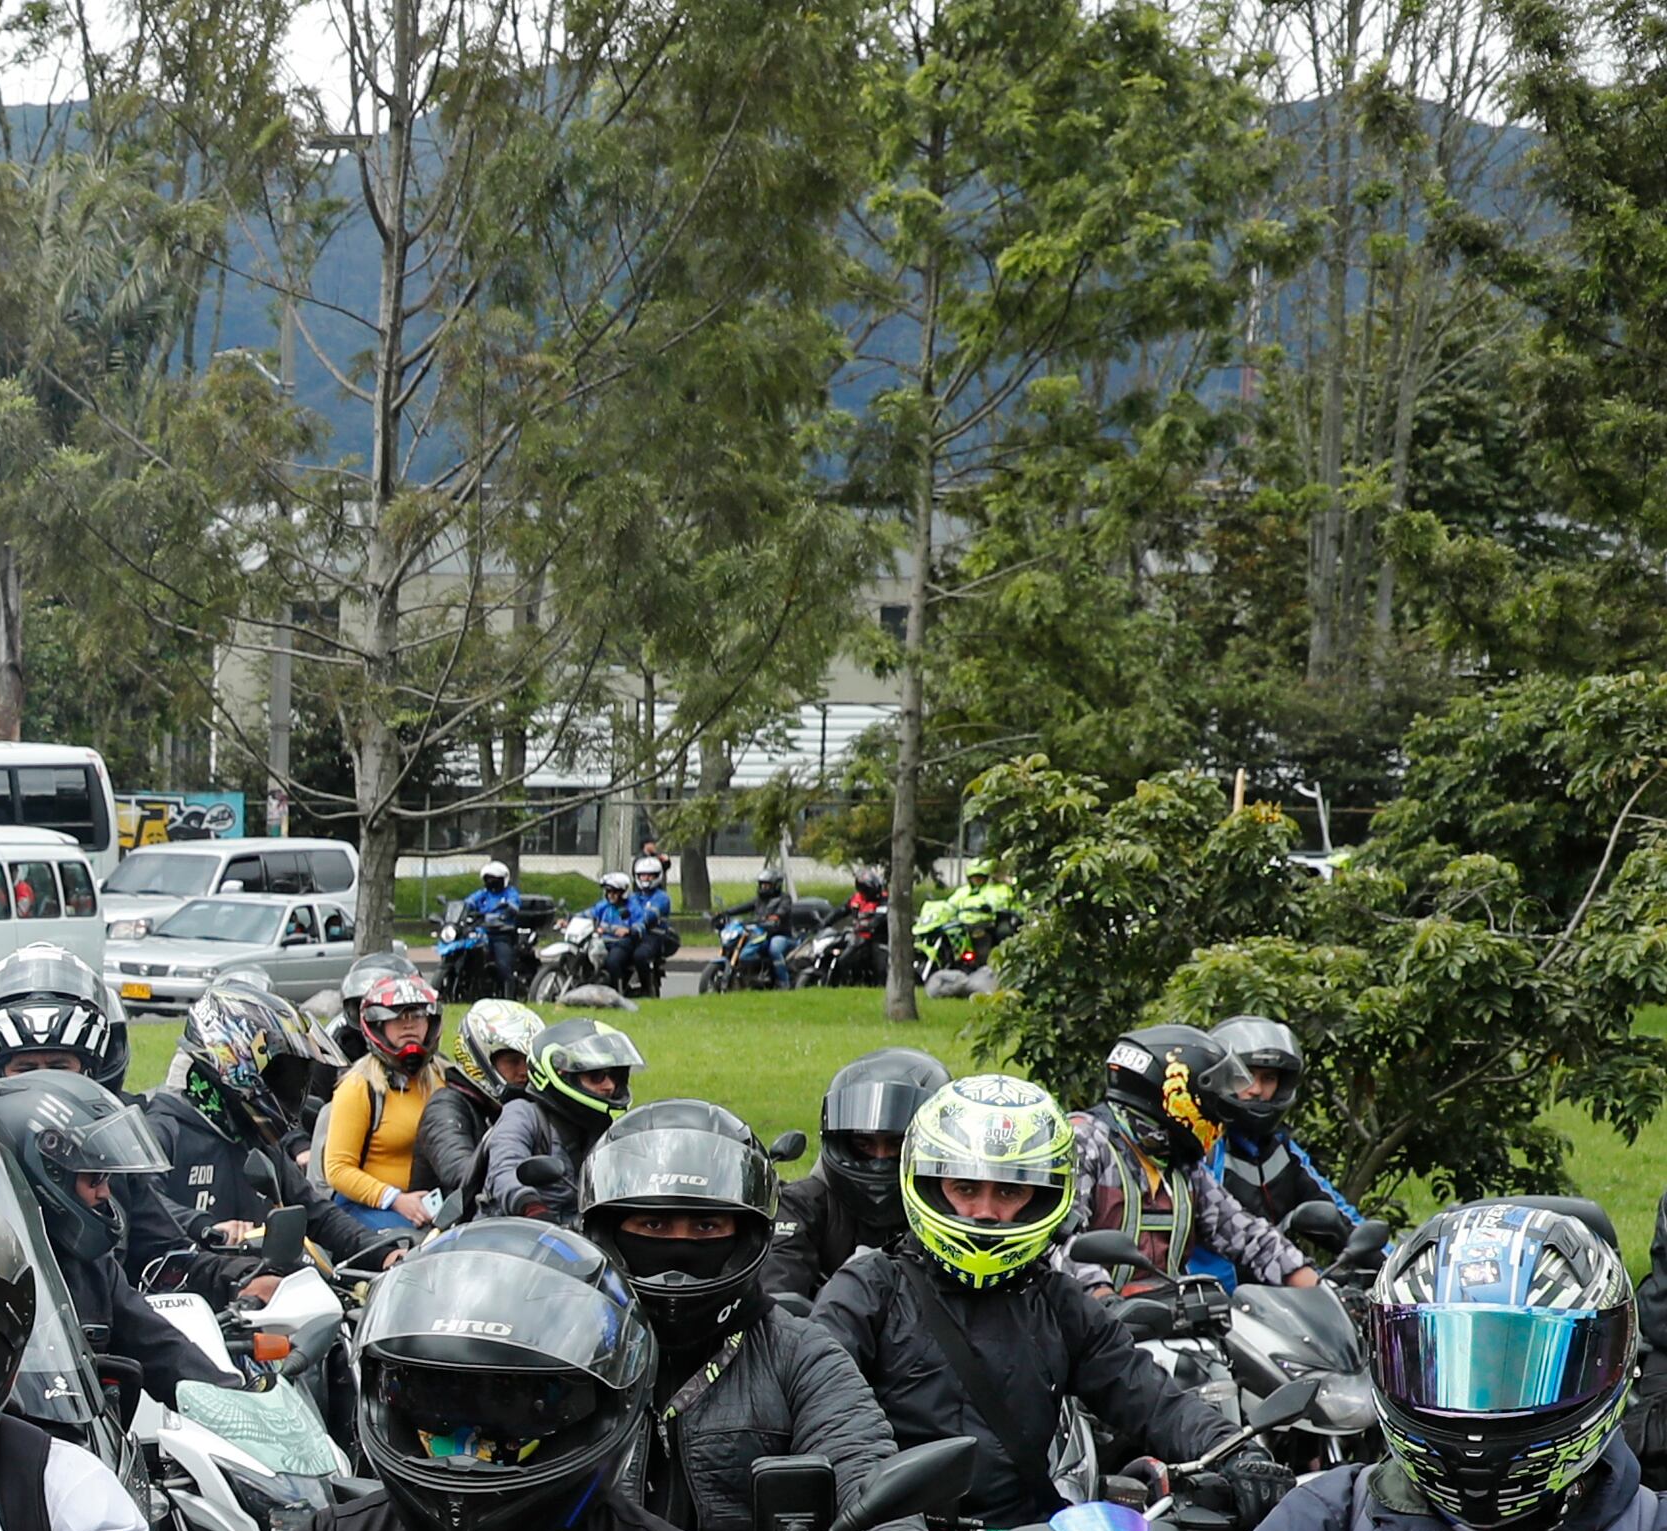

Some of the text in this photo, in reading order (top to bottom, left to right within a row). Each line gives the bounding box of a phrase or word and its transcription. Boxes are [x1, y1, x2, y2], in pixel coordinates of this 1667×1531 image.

[188, 1164, 215, 1186] 200
[648, 1173, 709, 1187] HRO
[147, 1296, 196, 1310] UZUKI
[430, 1319, 514, 1337] HRO
